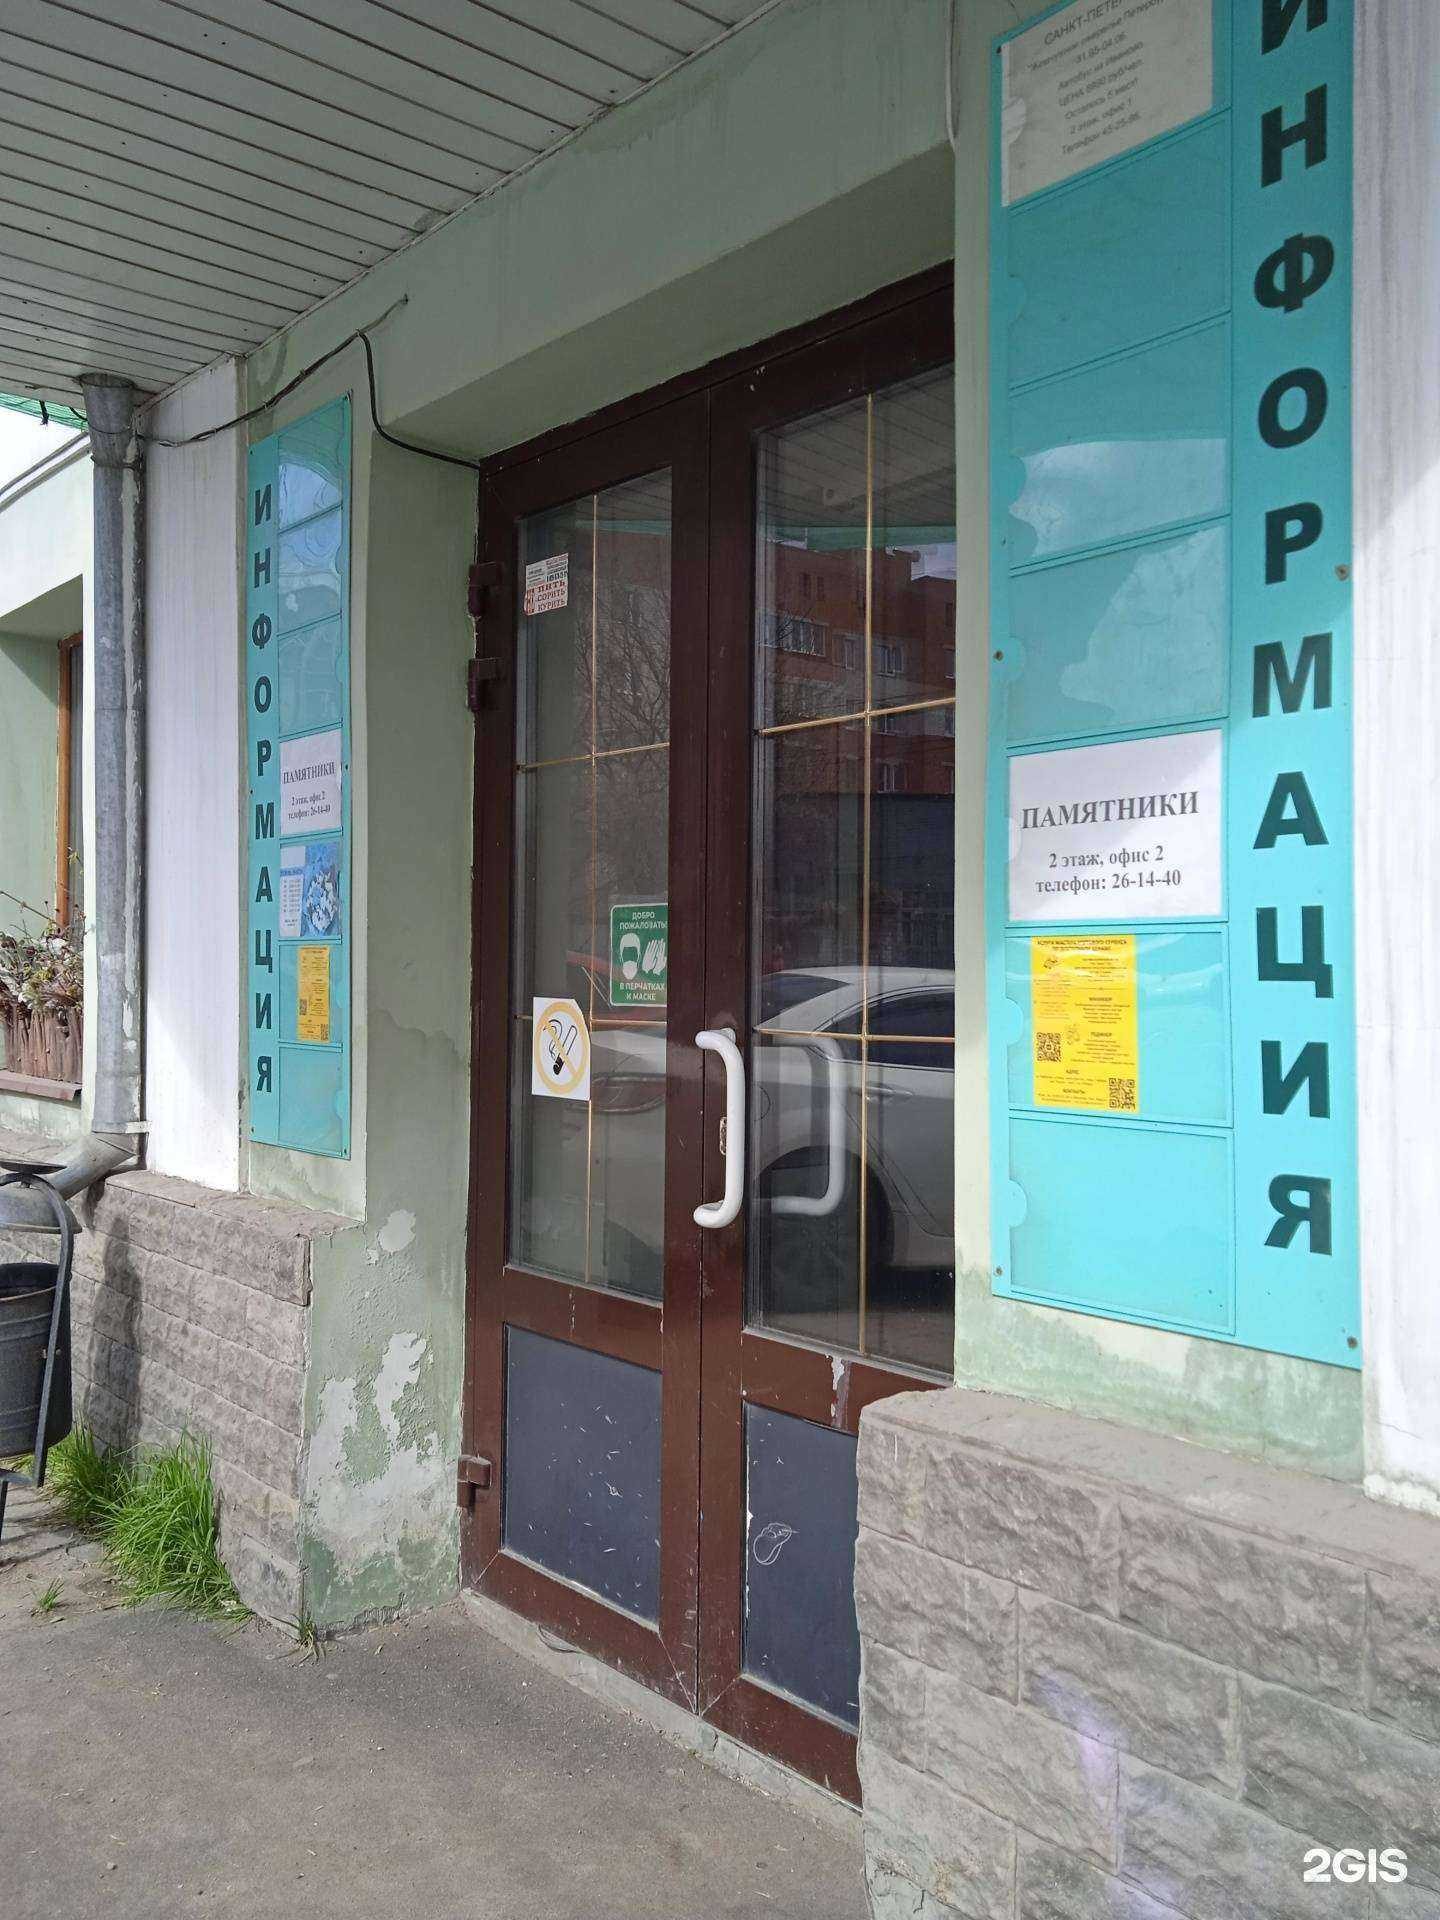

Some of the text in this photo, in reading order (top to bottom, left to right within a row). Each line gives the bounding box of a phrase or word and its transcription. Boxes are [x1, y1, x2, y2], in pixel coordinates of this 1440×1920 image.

[1044, 0, 1121, 45] САНКТ-ПЕТЕ
[283, 761, 335, 785] ПАМЯТНИКИ
[252, 483, 275, 1094] ИНФОРМАЦИЯ
[1022, 791, 1199, 829] ПАМЯТНИКИ
[1049, 845, 1163, 868] 2 этаж, офис 2
[1036, 870, 1181, 895] телефон: 26-14-40
[632, 911, 655, 920] ДОБРО
[626, 981, 665, 991] ПЕРЧАТКАХ
[632, 992, 657, 1001] МАСКЕ
